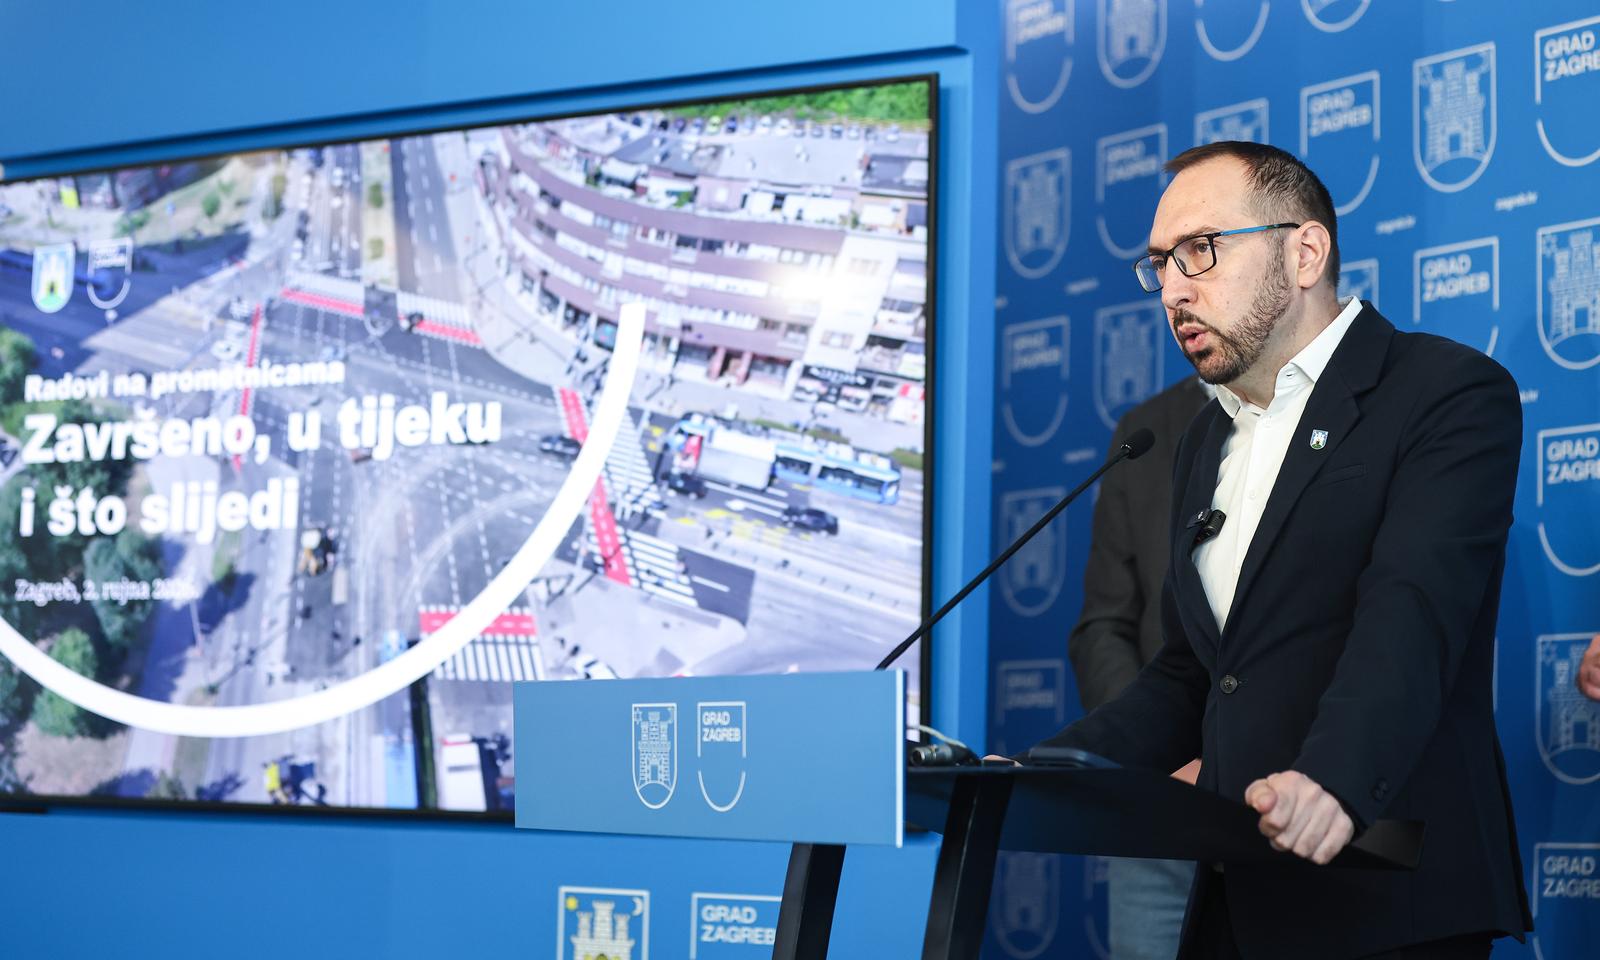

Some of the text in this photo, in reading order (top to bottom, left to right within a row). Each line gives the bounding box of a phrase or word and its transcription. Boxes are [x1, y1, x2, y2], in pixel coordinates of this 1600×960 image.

[1544, 30, 1595, 60] GRAD
[1422, 253, 1472, 280] GRAD
[1422, 271, 1490, 302] ZAGREB
[24, 359, 345, 401] Radovi na prometnicama
[22, 392, 502, 464] Završeno, u tijeku
[1546, 437, 1599, 462] GRAD
[18, 476, 300, 545] i što slijedi
[15, 577, 81, 607] Zagreb,
[102, 576, 150, 606] rujna
[702, 711, 731, 726] GRAD
[702, 727, 741, 742] ZAGREB
[1543, 855, 1596, 876] GRAD
[701, 904, 758, 924] GRAD
